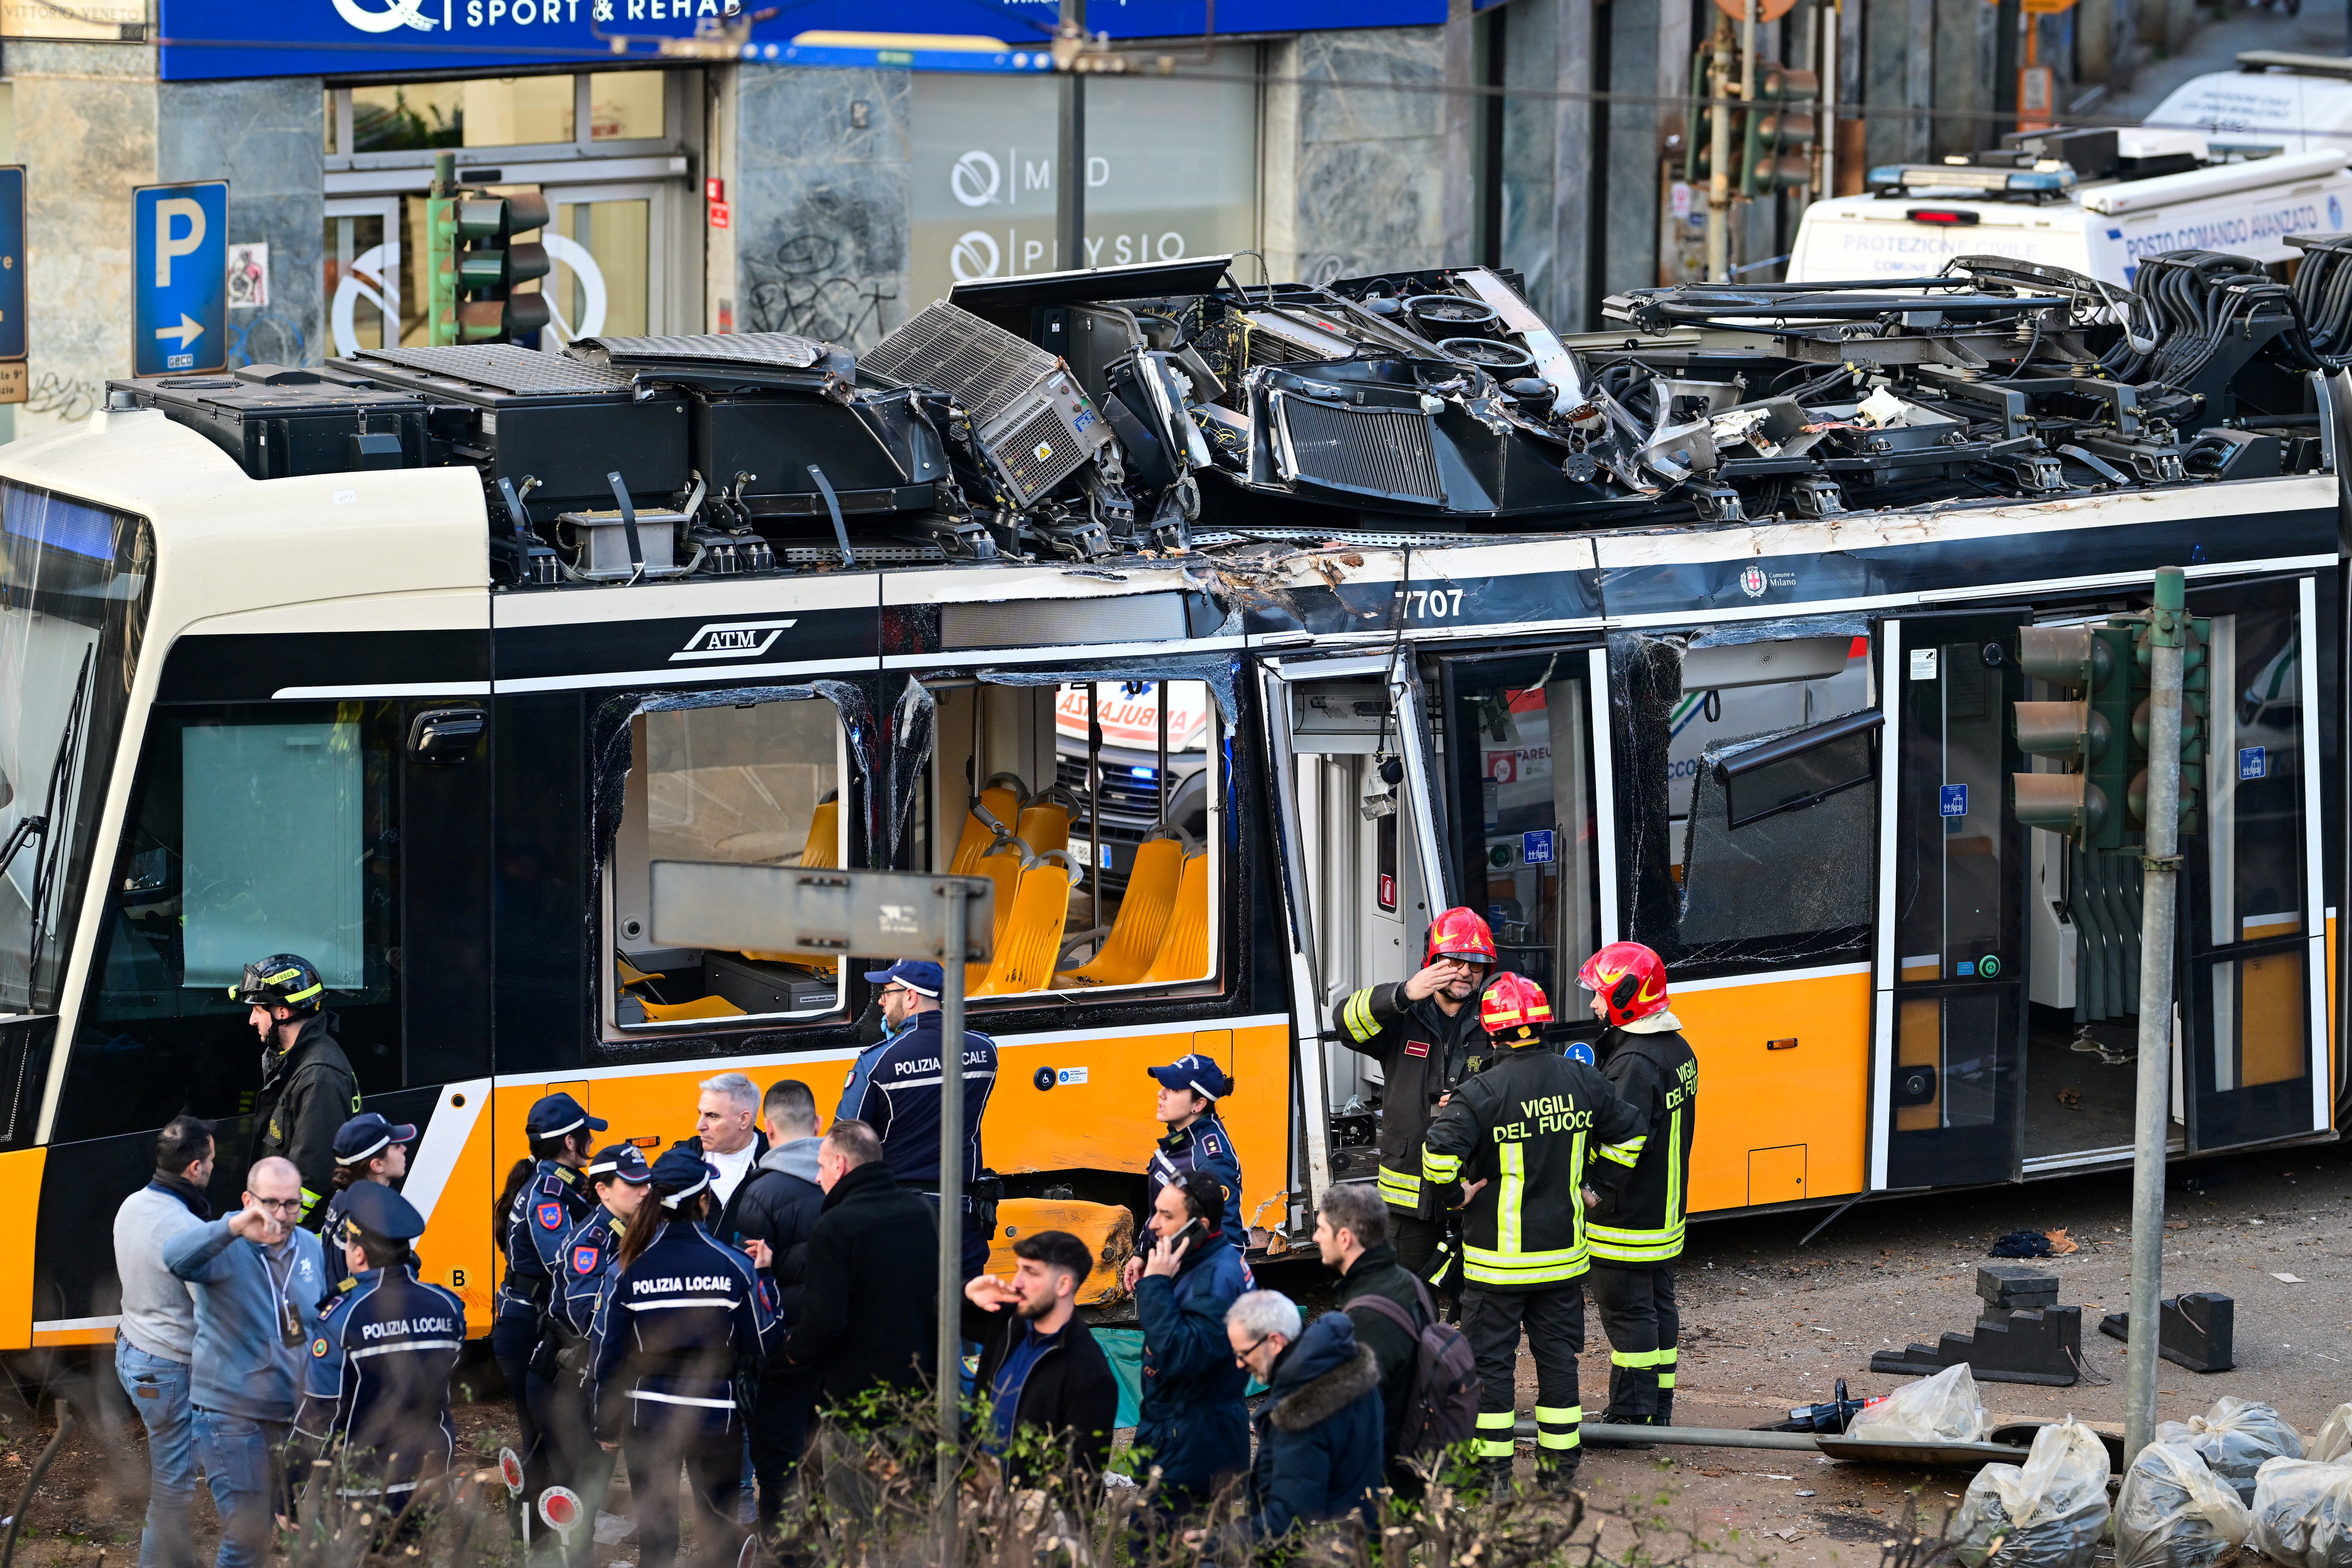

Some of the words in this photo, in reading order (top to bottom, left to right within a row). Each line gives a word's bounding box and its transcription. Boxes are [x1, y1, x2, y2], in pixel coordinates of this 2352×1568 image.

[81, 7, 138, 21] VENETO
[467, 0, 580, 27] SPORT
[1025, 157, 1110, 191] MD
[156, 197, 207, 288] P
[1844, 234, 1968, 254] PROTEZIONE
[1975, 239, 2037, 258] CIVILE
[2126, 231, 2175, 263] POSTO
[2178, 219, 2248, 250] COMANDO
[2251, 205, 2319, 239] AVANZATO
[1025, 231, 1185, 271] PYSIO
[1770, 578, 1796, 587] Milano
[1395, 589, 1463, 618] 7707
[706, 630, 756, 650] ATM
[277, 971, 294, 981] FUOCO
[894, 1057, 941, 1076] POLIZIA
[962, 1050, 988, 1066] CALE
[1521, 1094, 1574, 1119] VIGILI
[1666, 1087, 1684, 1109] DEL
[1493, 1121, 1532, 1143] DEL
[453, 1270, 465, 1287] B
[632, 1277, 683, 1296] POLIZIA
[362, 1319, 411, 1341] POLIZIA
[412, 1317, 453, 1333] LOCALE
[541, 1490, 554, 1512] COMUNE
[565, 1492, 582, 1515] MILANO
